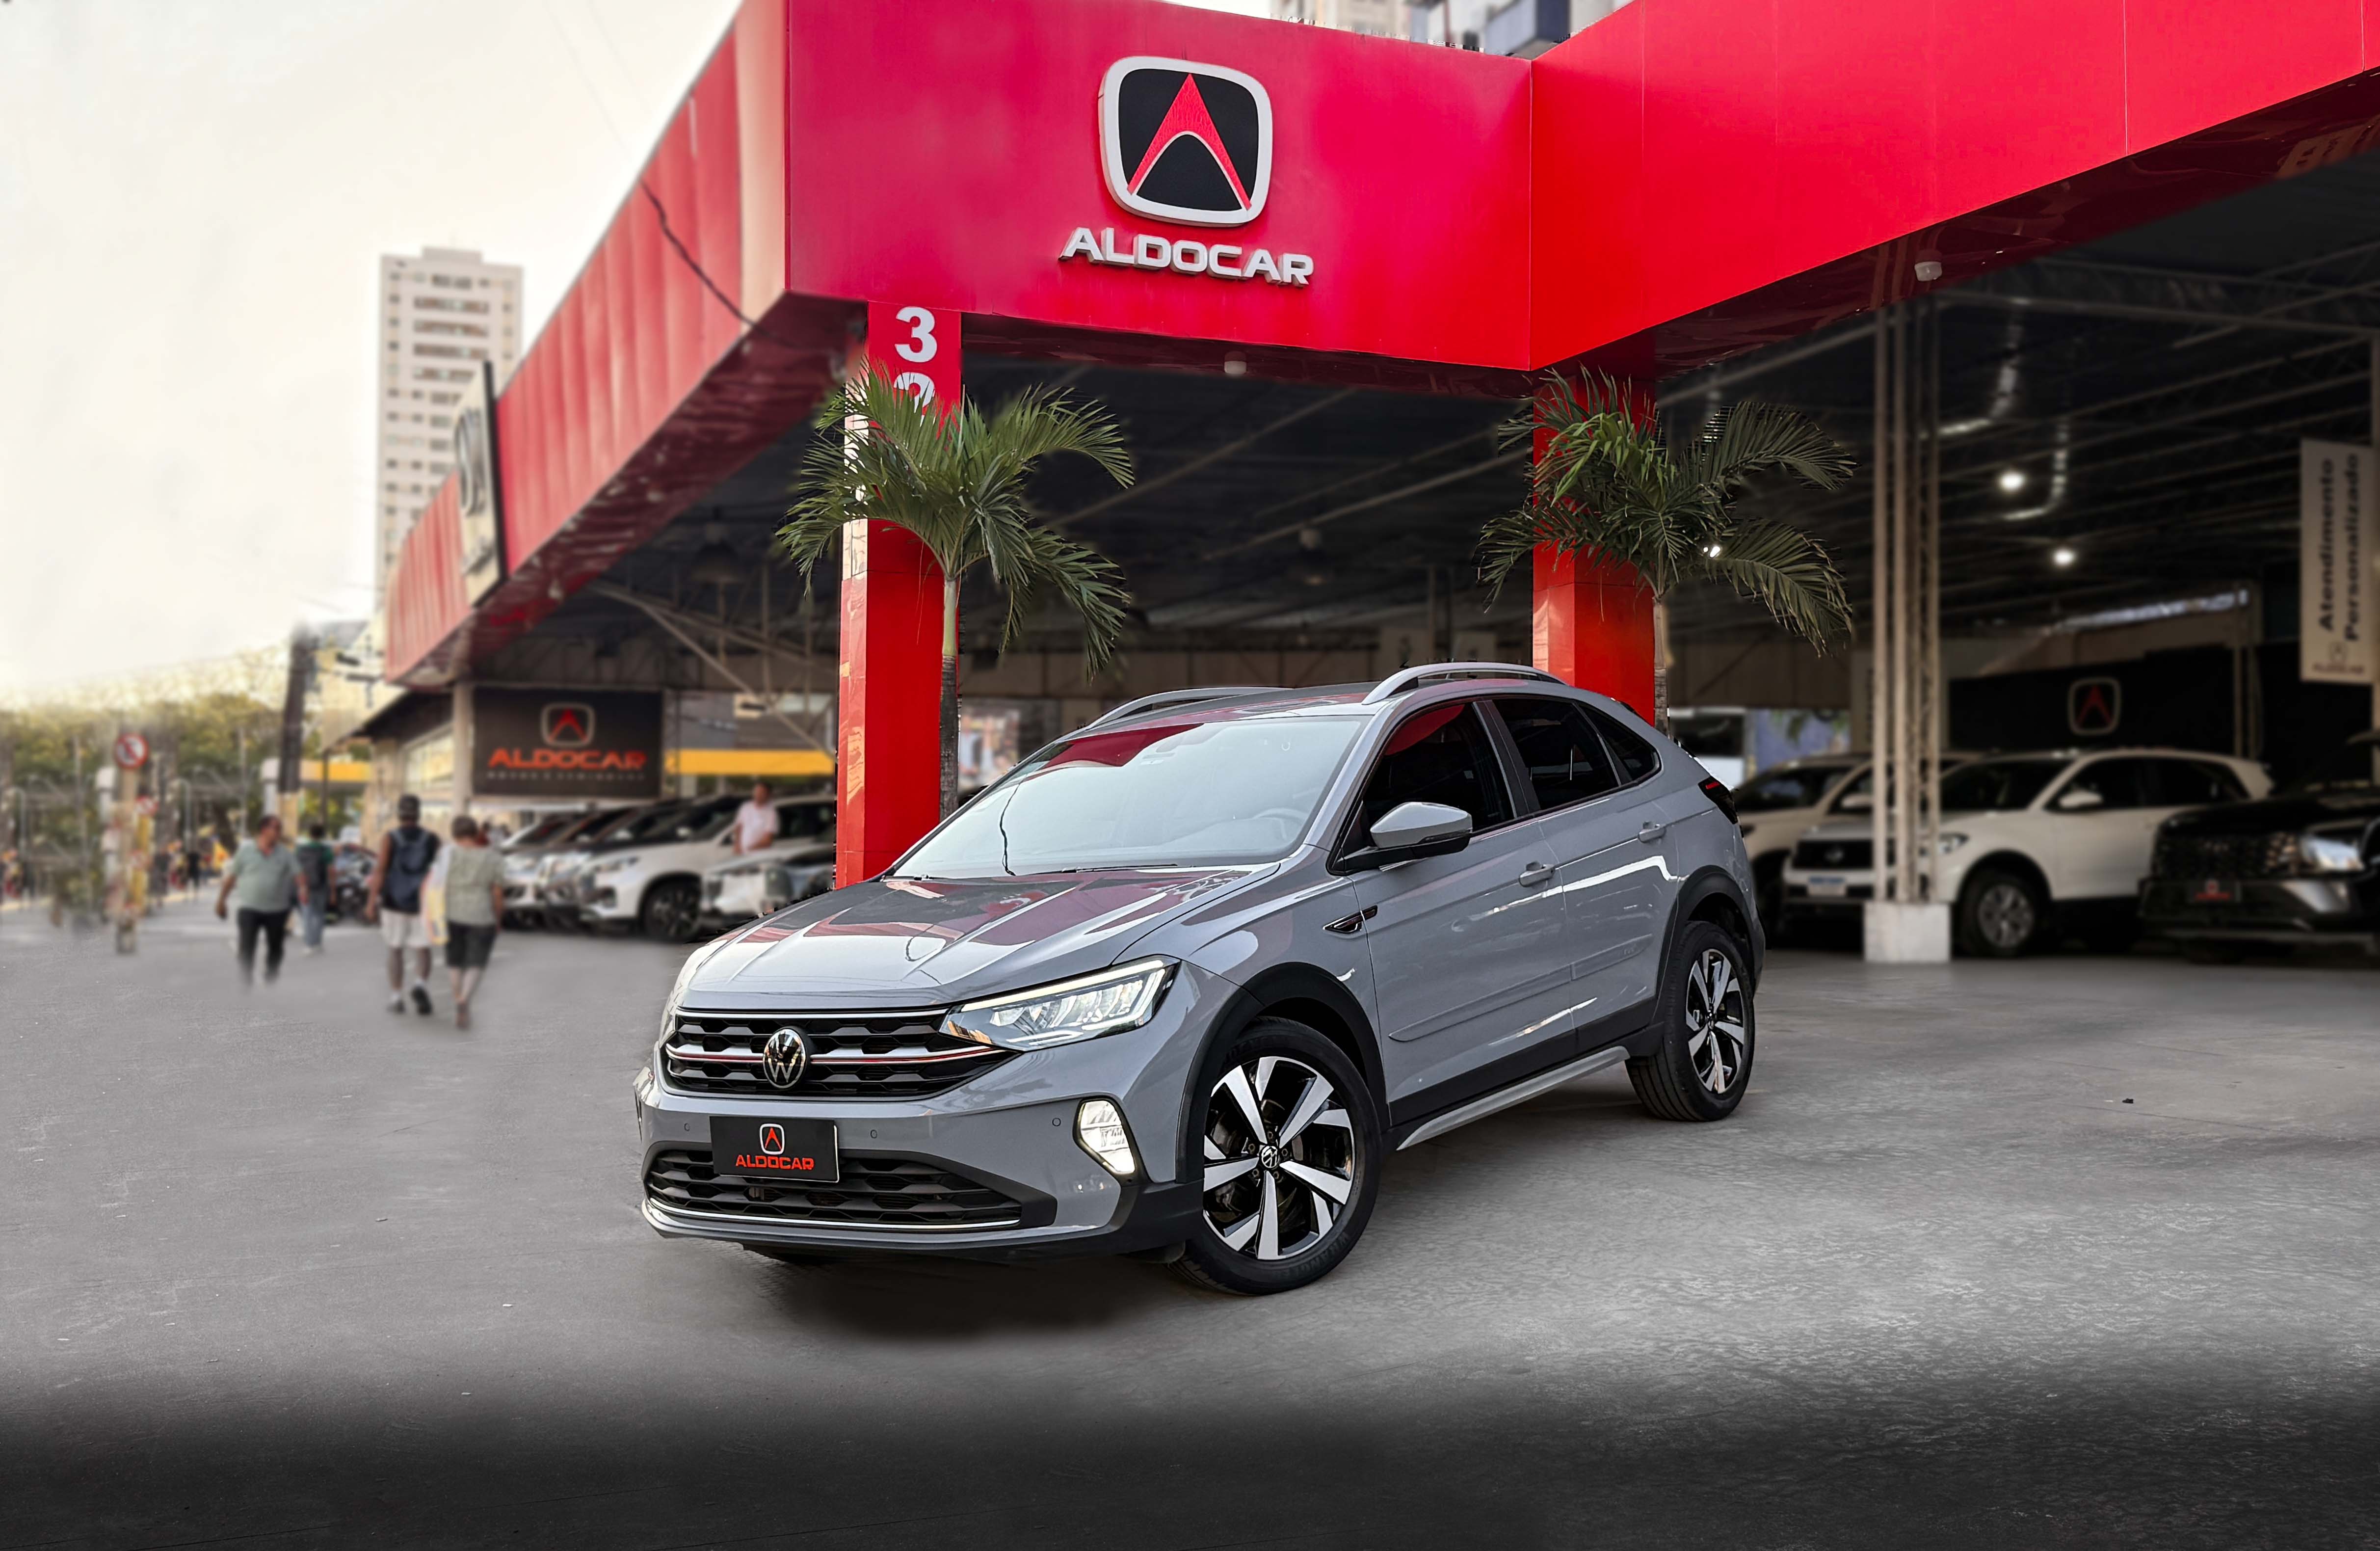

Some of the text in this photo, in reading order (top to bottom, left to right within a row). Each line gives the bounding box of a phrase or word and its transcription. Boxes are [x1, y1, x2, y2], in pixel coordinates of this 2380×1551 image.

[1058, 226, 1314, 287] ALDOCAR
[2318, 458, 2334, 632] Atendimento
[488, 748, 647, 771] ALDOCAR
[736, 1154, 815, 1170] ALDOCAR
